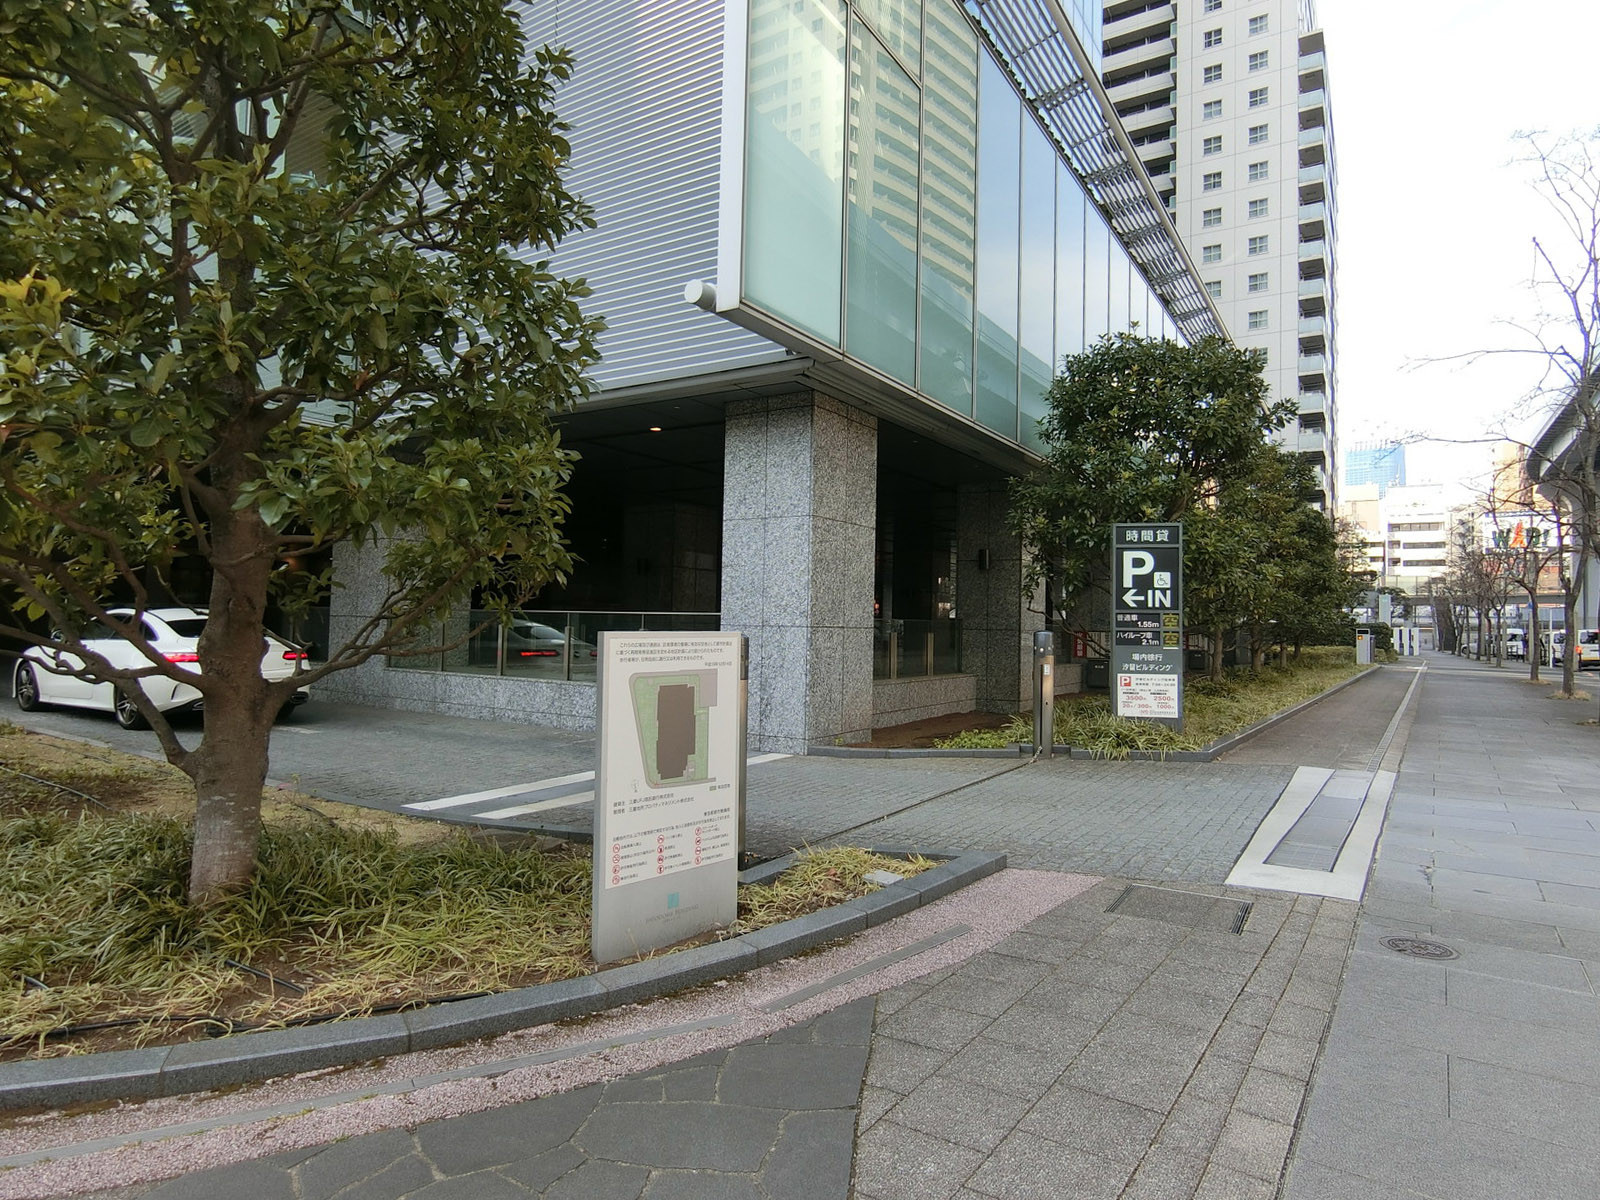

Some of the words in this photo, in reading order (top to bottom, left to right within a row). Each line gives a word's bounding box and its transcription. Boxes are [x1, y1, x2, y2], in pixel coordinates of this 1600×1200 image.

[1125, 529, 1169, 542] 時間貸
[1122, 550, 1155, 588] P
[1147, 589, 1171, 608] IN
[1163, 613, 1179, 629] 空
[1163, 631, 1179, 647] 空
[1131, 653, 1163, 661] 場内徐行
[1122, 663, 1173, 671] 汐留ビルディング
